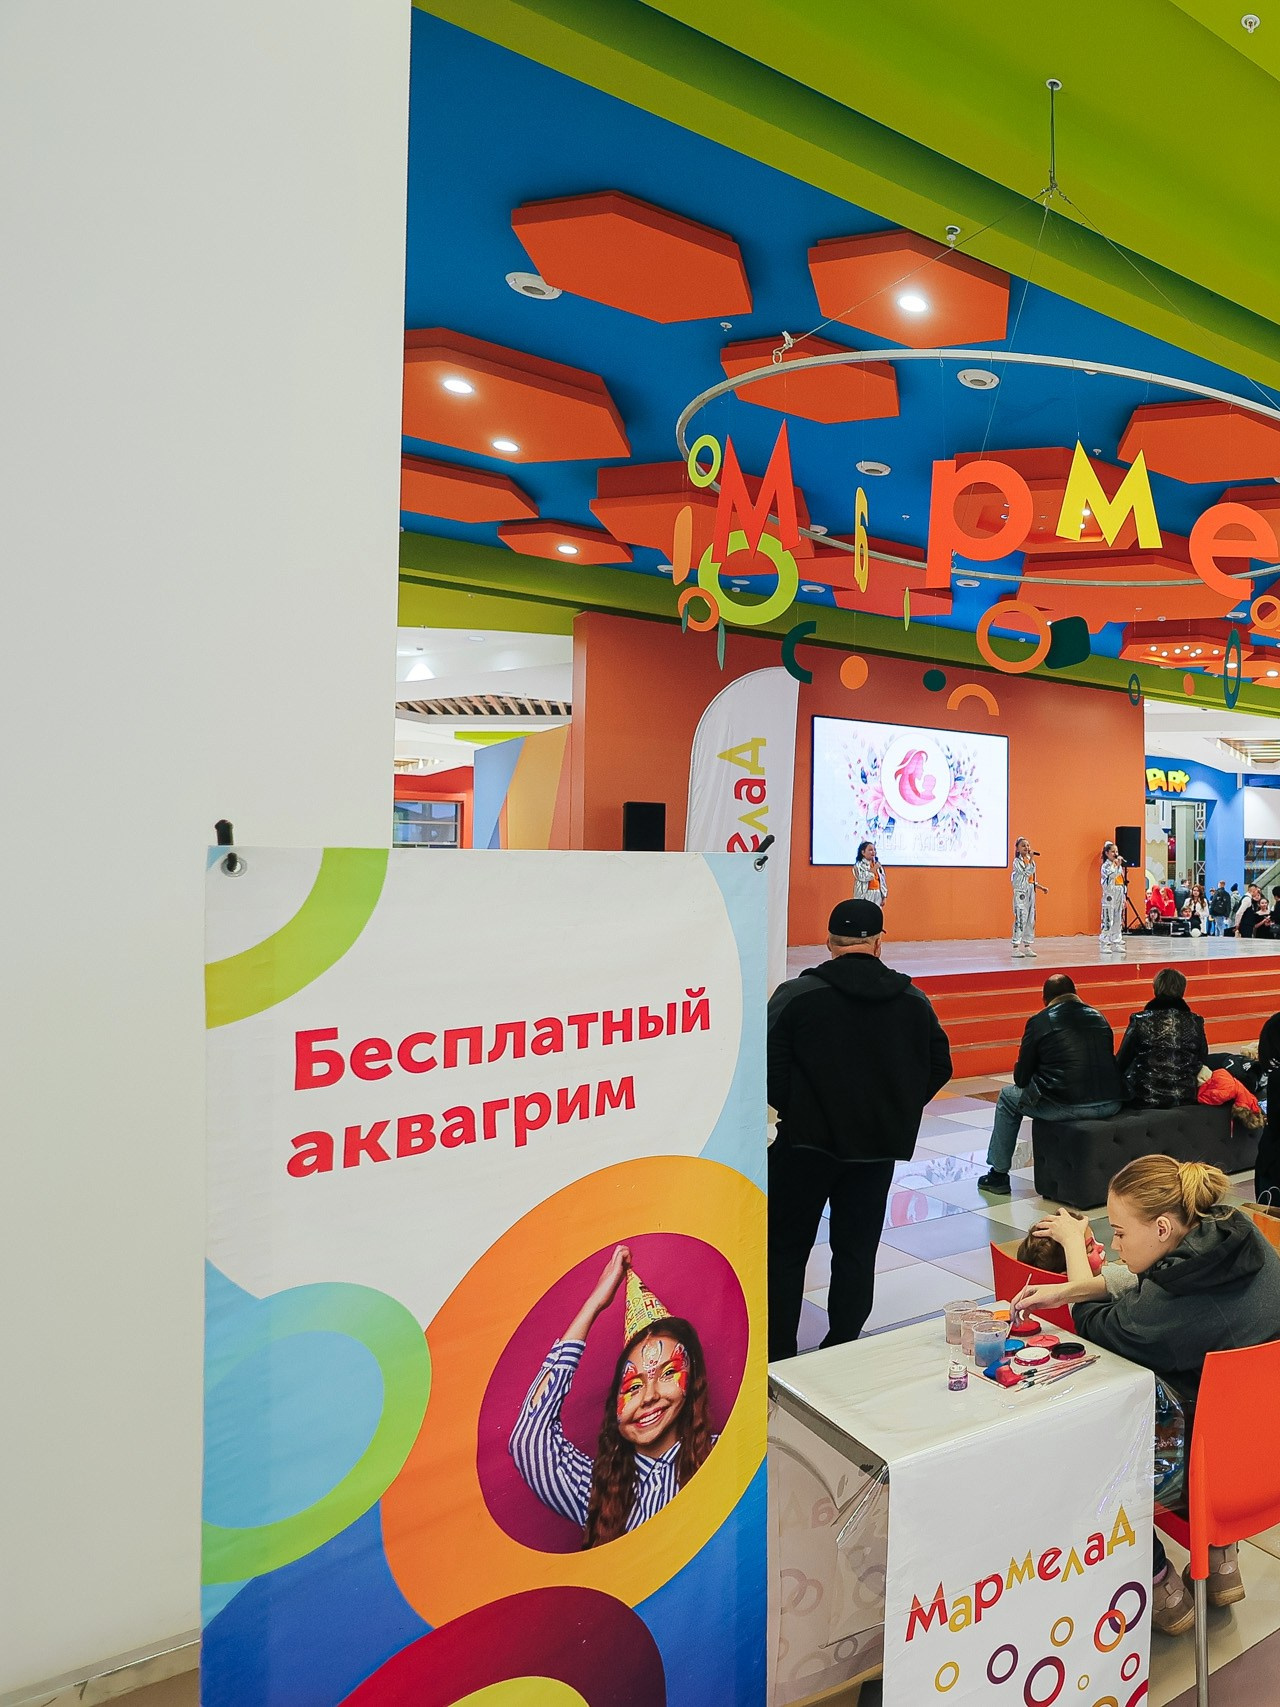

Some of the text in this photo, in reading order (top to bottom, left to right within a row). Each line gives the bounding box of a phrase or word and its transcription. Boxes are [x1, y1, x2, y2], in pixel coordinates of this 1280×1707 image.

[1145, 767, 1190, 793] PARK
[294, 986, 712, 1091] Бесплатный
[286, 1075, 637, 1179] аквагрим
